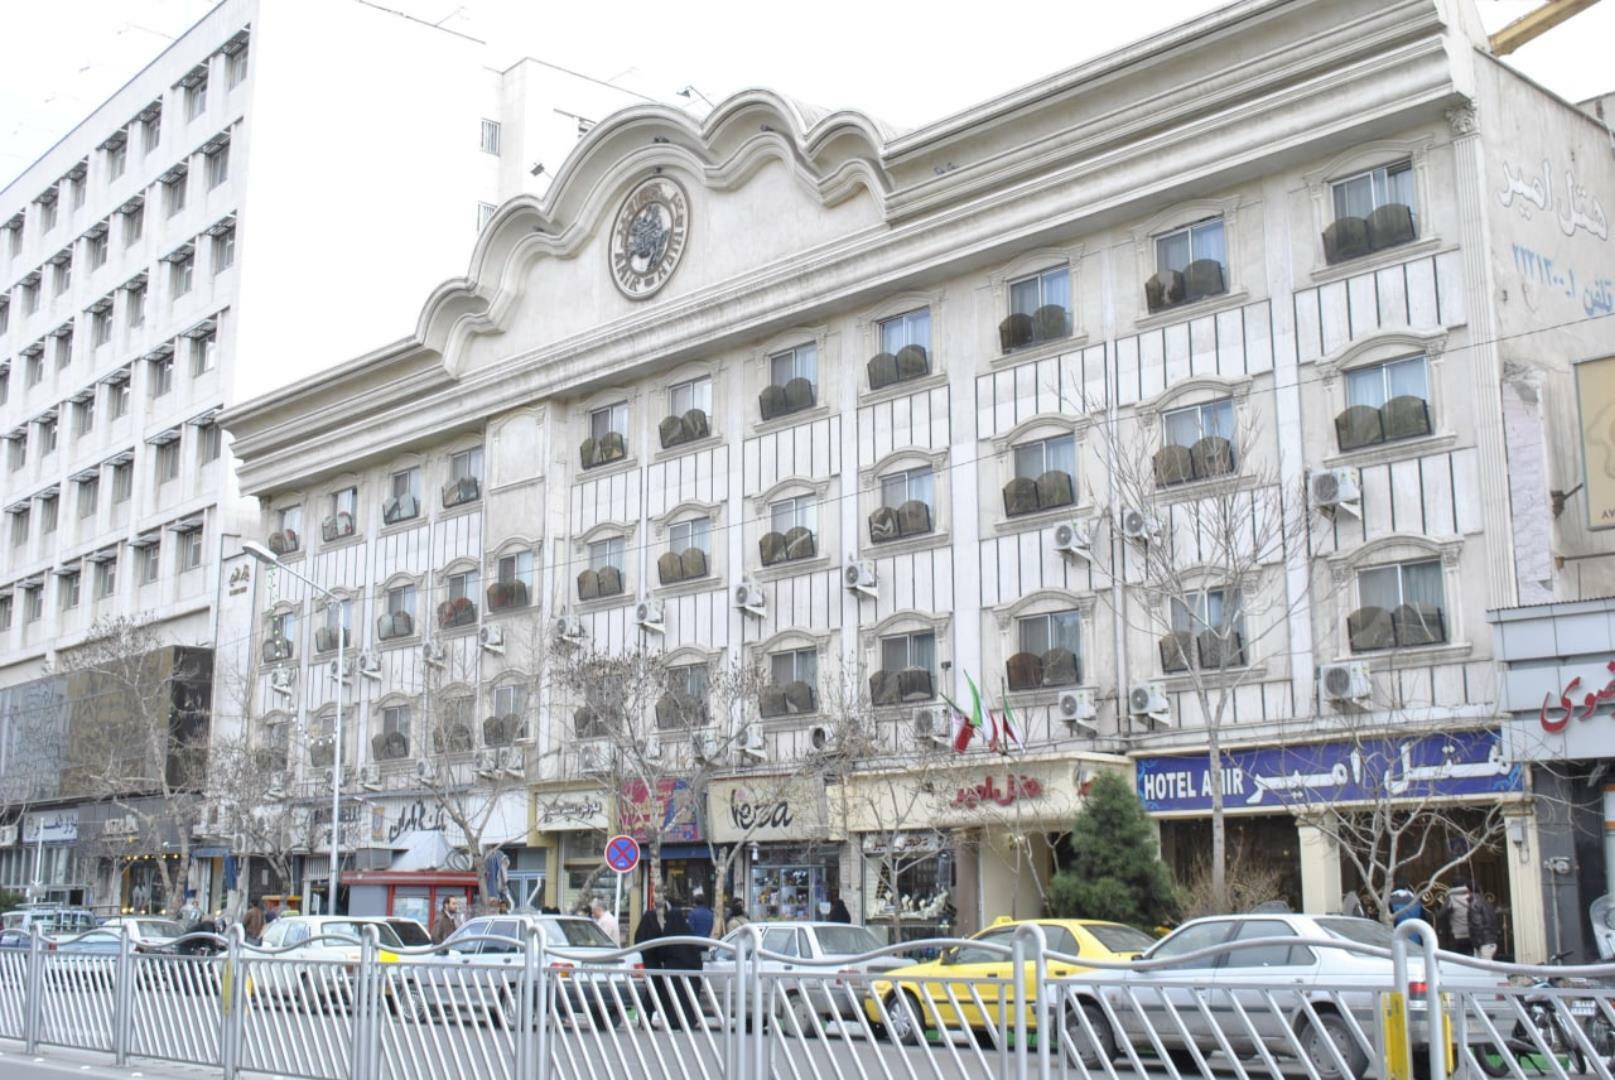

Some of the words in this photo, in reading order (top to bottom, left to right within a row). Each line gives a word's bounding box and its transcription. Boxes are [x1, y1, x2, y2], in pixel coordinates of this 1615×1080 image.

[1497, 158, 1552, 221] امیر
[1557, 170, 1609, 242] هتل
[1583, 279, 1612, 316] تلفن
[1144, 771, 1197, 800] HOTEL
[1246, 747, 1361, 804] امیر
[1384, 741, 1511, 795] هتل
